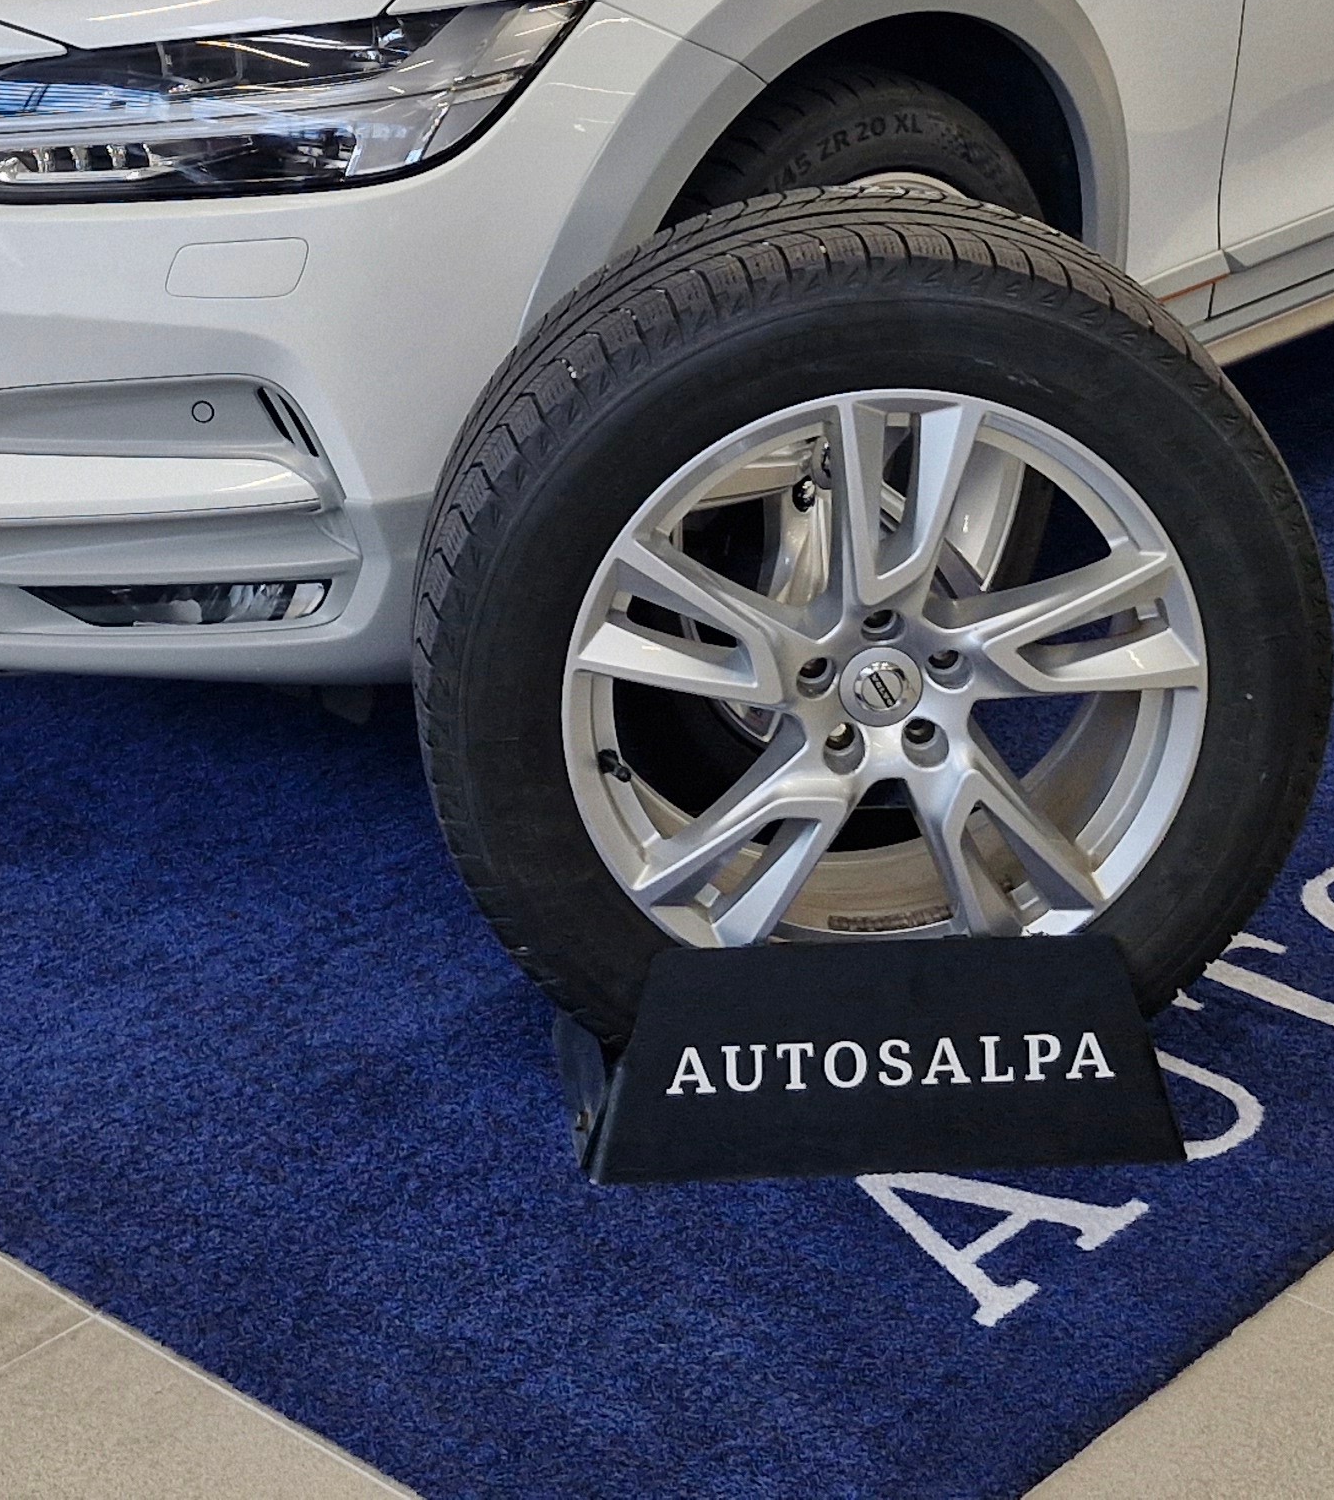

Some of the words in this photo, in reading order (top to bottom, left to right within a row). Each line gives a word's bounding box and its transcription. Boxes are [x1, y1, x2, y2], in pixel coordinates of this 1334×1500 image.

[770, 152, 813, 192] /45
[816, 130, 851, 162] ZR
[854, 115, 887, 143] 20
[893, 112, 924, 136] XL
[665, 1030, 1117, 1097] AUTOSALPA
